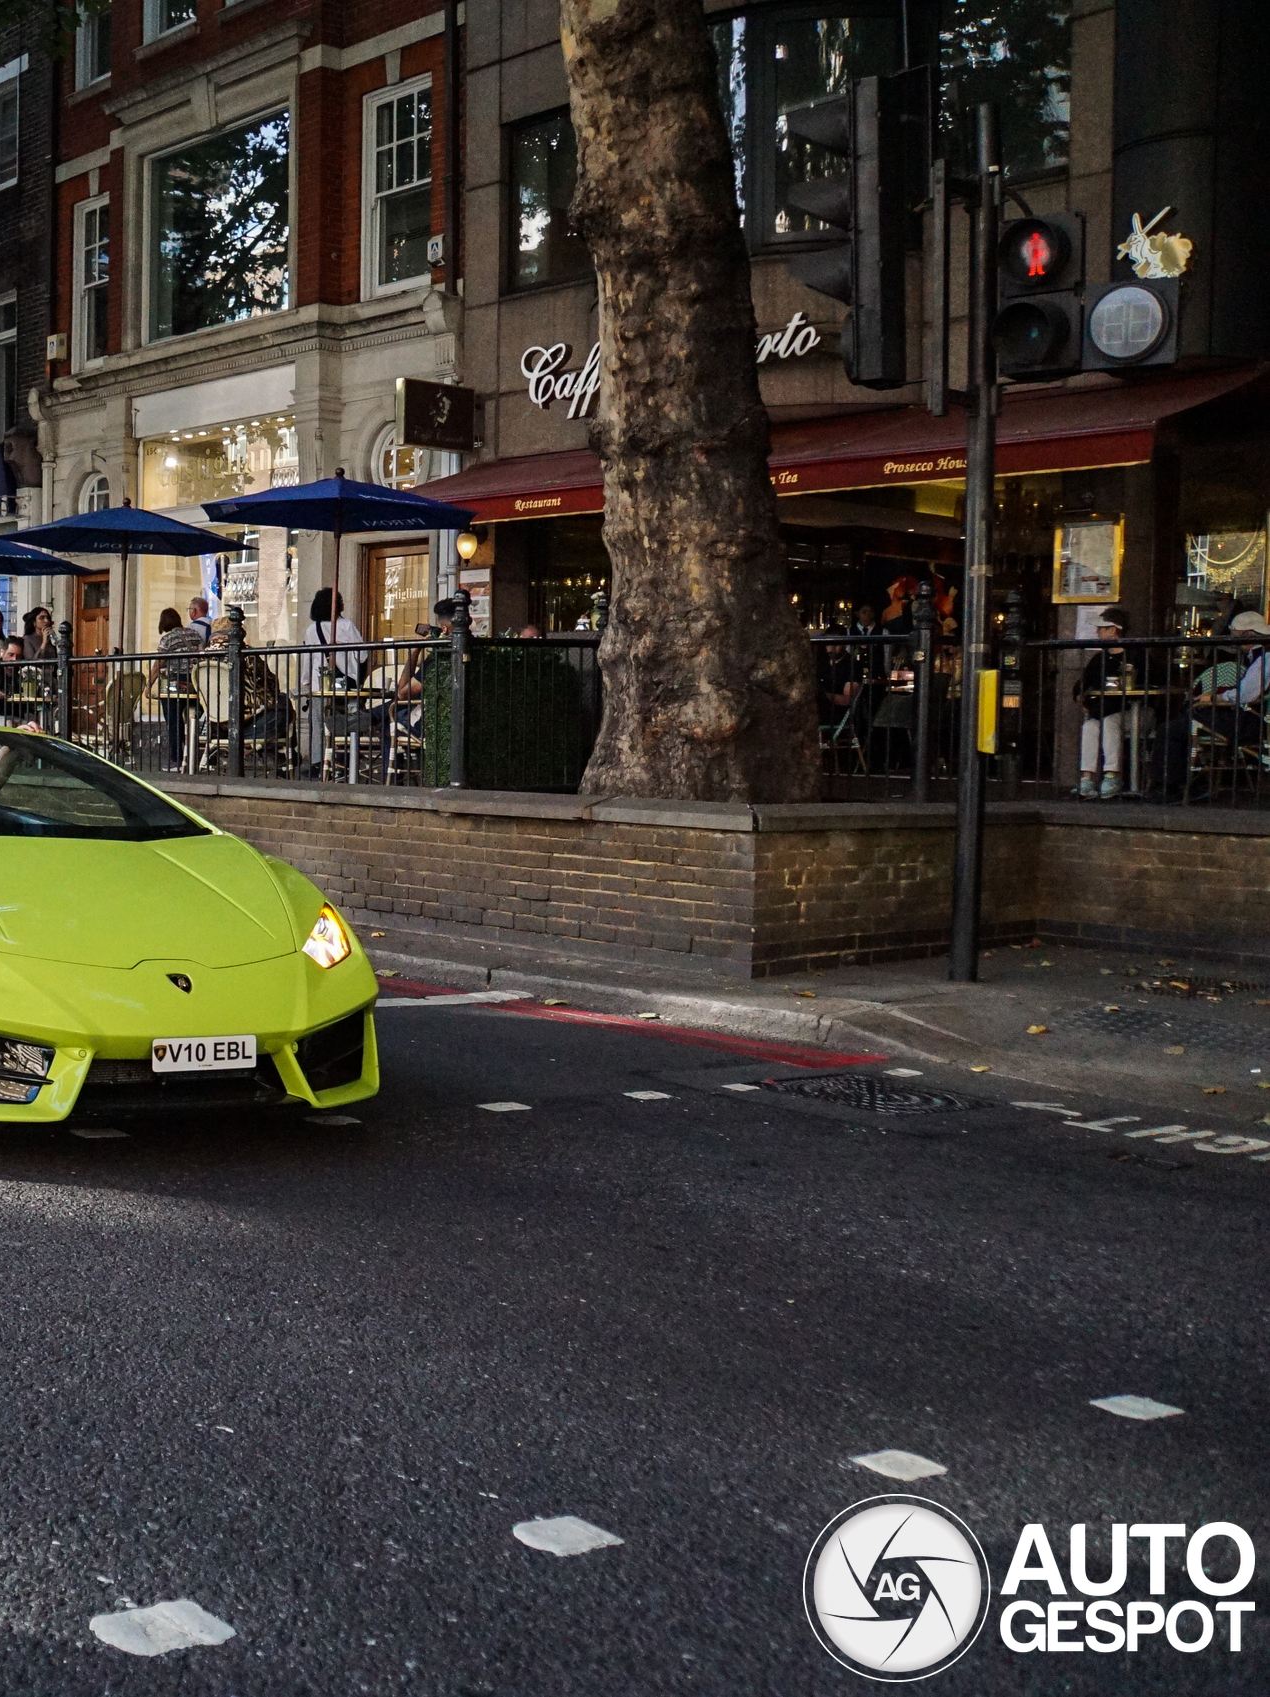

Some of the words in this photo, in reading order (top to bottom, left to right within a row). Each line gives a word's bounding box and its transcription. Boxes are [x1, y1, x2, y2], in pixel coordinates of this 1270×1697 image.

[521, 341, 601, 420] Caff
[756, 311, 821, 364] rto
[883, 461, 934, 475] Prosecco
[935, 456, 968, 471] Hous
[778, 470, 798, 484] Tea
[514, 496, 562, 512] Restaurant
[394, 588, 428, 602] tigliano
[168, 1043, 206, 1062] V10
[214, 1041, 252, 1061] EBL
